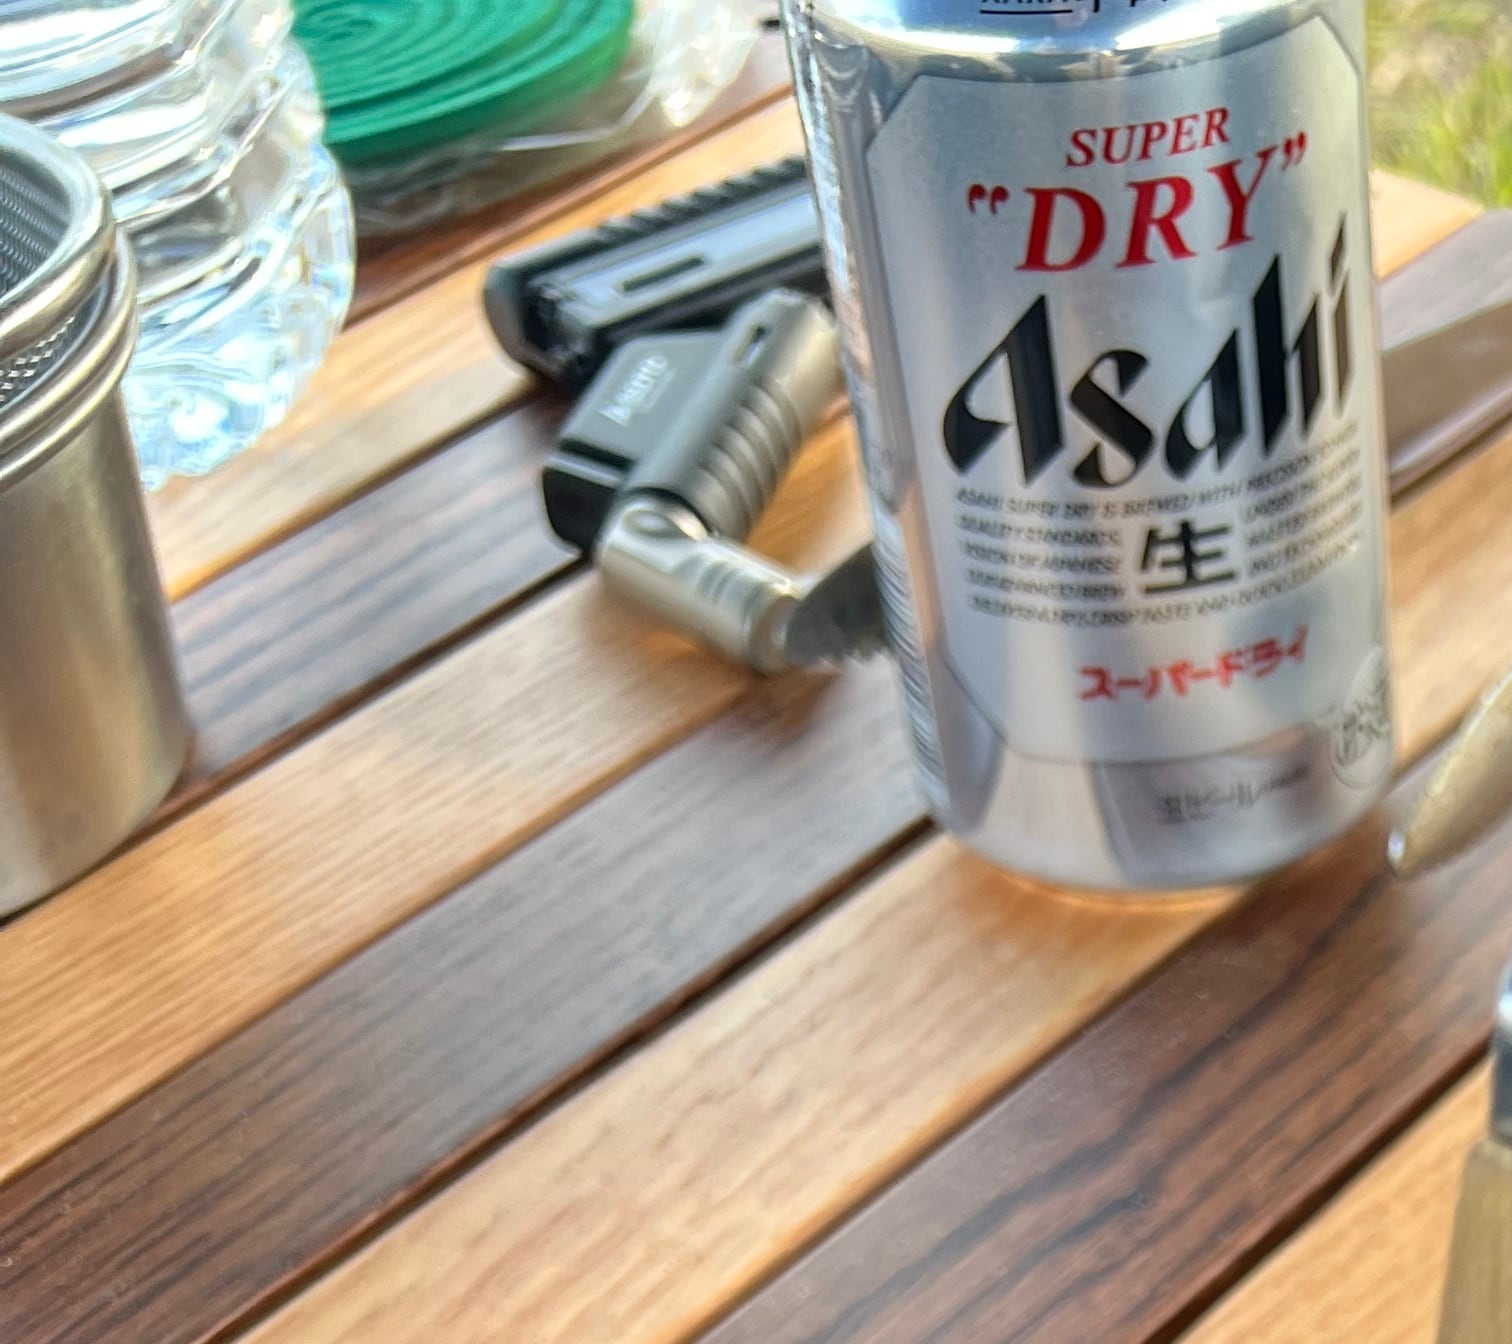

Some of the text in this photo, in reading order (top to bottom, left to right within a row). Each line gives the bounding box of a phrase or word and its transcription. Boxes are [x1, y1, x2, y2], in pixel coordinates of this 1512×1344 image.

[1065, 106, 1230, 169] SUPER
[943, 210, 1352, 487] Asahi
[1139, 520, 1238, 595] 生
[1080, 625, 1309, 702] スーパードライ
